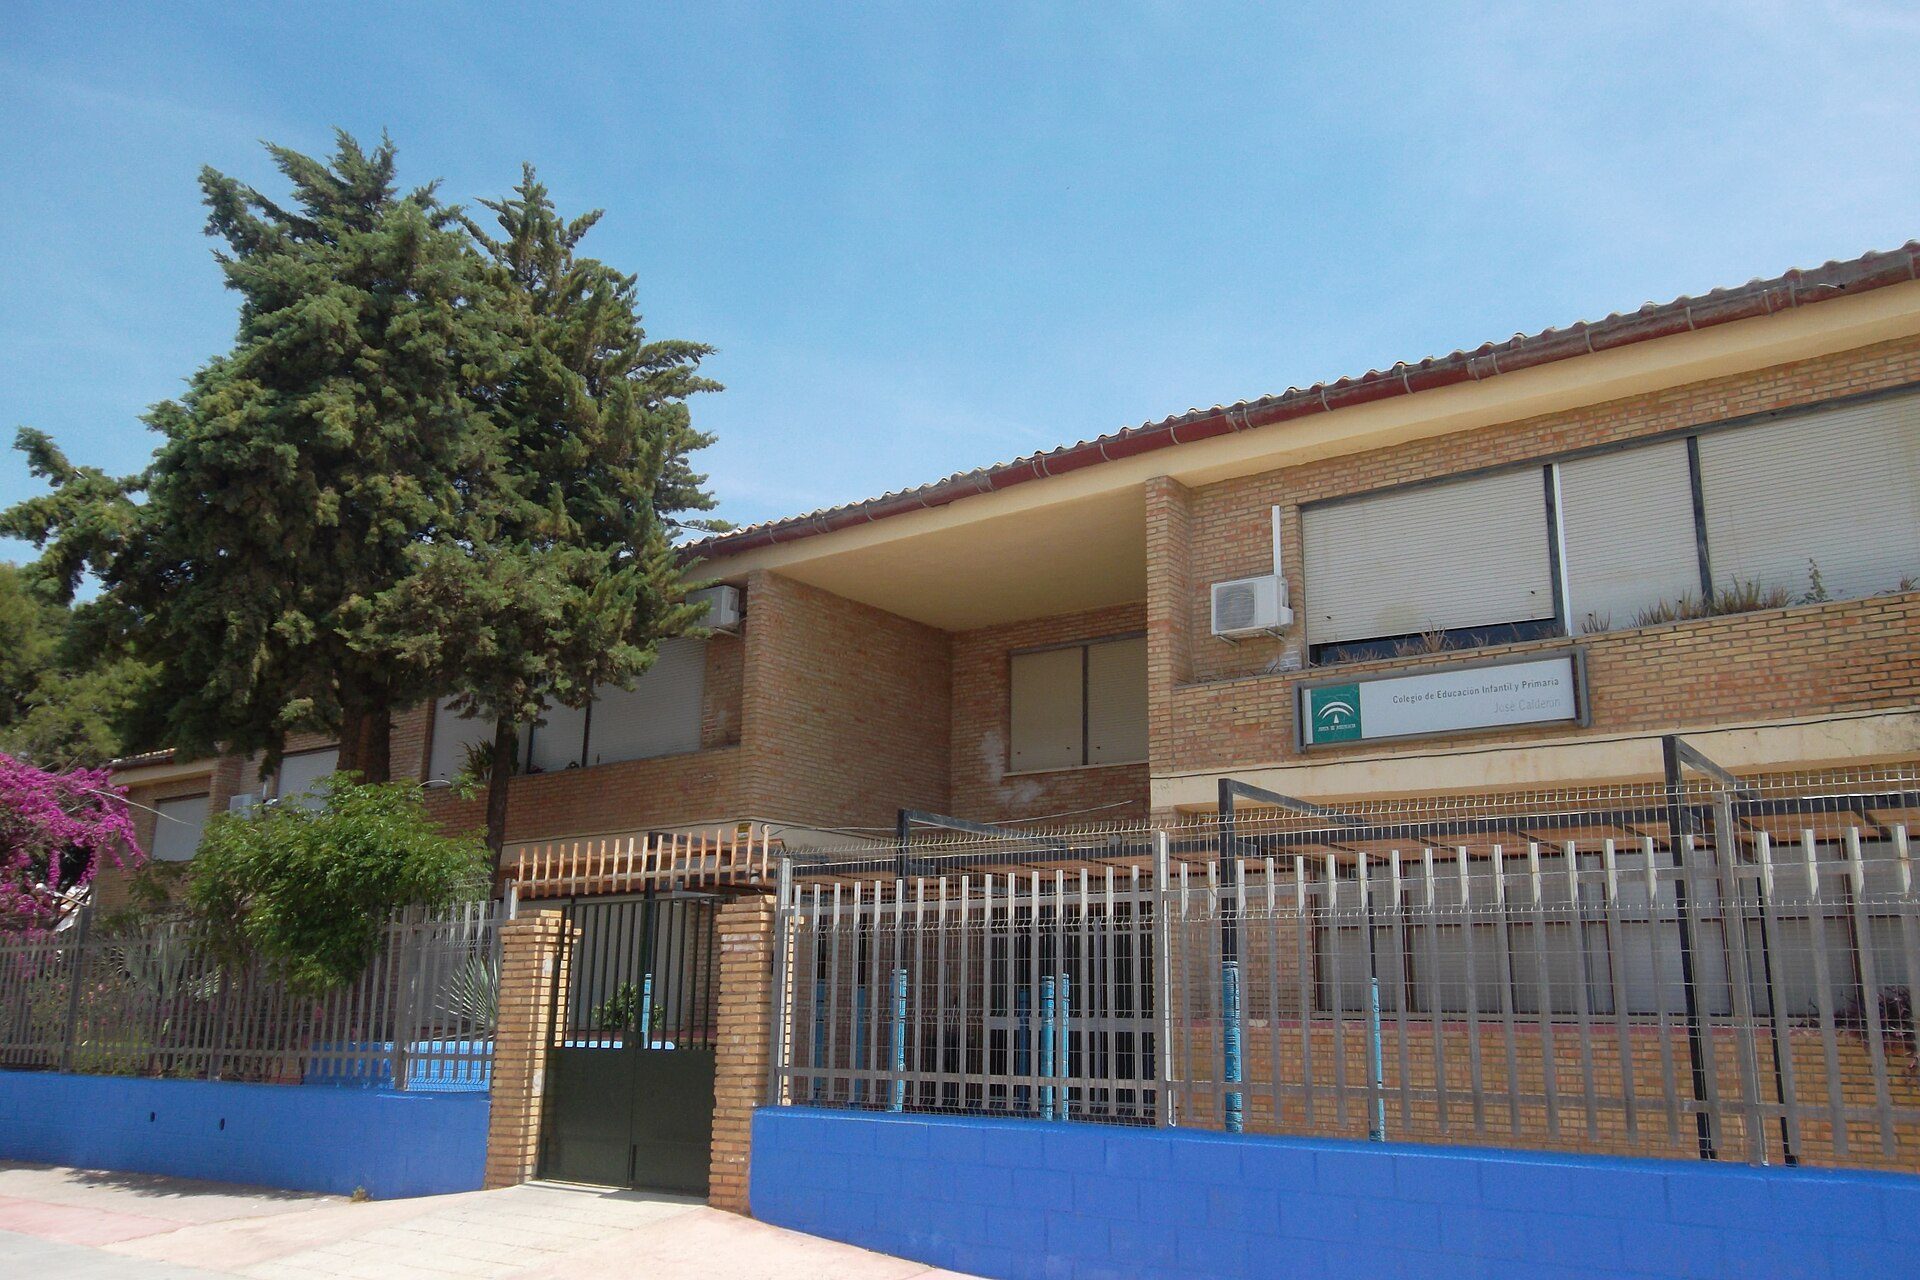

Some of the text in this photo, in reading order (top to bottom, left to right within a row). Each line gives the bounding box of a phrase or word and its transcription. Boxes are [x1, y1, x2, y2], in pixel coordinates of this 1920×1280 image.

[1392, 694, 1423, 704] Colegio
[1424, 692, 1435, 701] de
[1482, 682, 1512, 694] Infantil
[1514, 684, 1519, 693] y
[1521, 679, 1559, 689] Primaria
